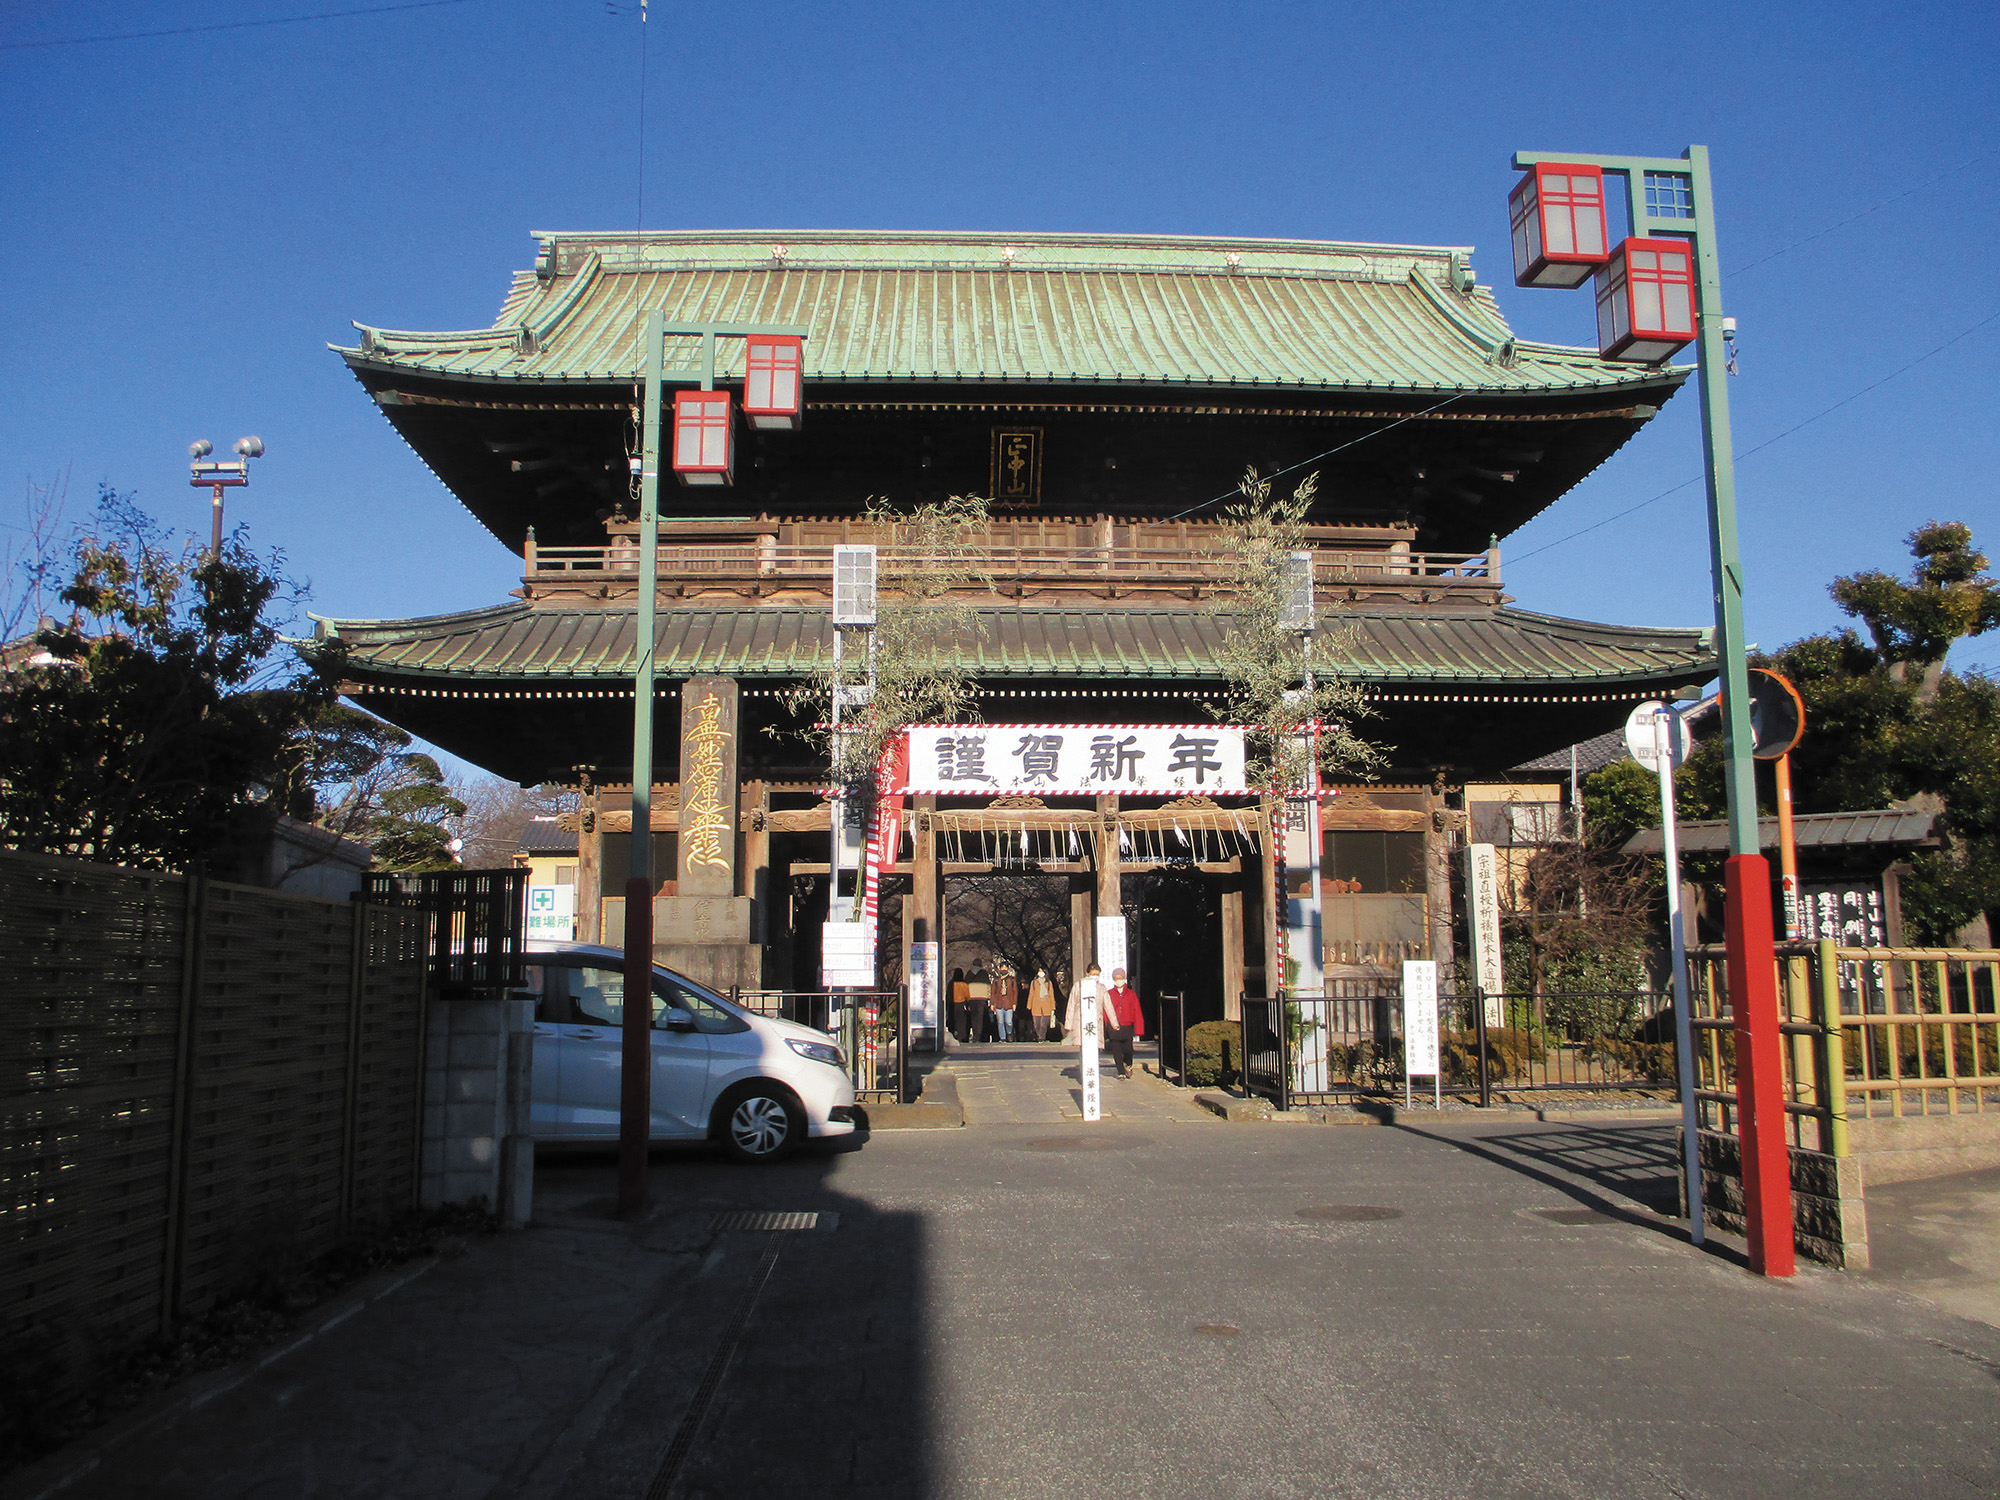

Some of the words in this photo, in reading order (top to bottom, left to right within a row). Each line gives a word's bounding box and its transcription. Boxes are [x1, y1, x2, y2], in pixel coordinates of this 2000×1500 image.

[934, 733, 1222, 785] 謹賀新年
[989, 776, 1046, 788] 大本山
[1080, 775, 1226, 788] 法華経寺
[522, 915, 570, 929] 難場所
[1818, 892, 1836, 939] 鬼子母
[1082, 996, 1097, 1036] 下乗
